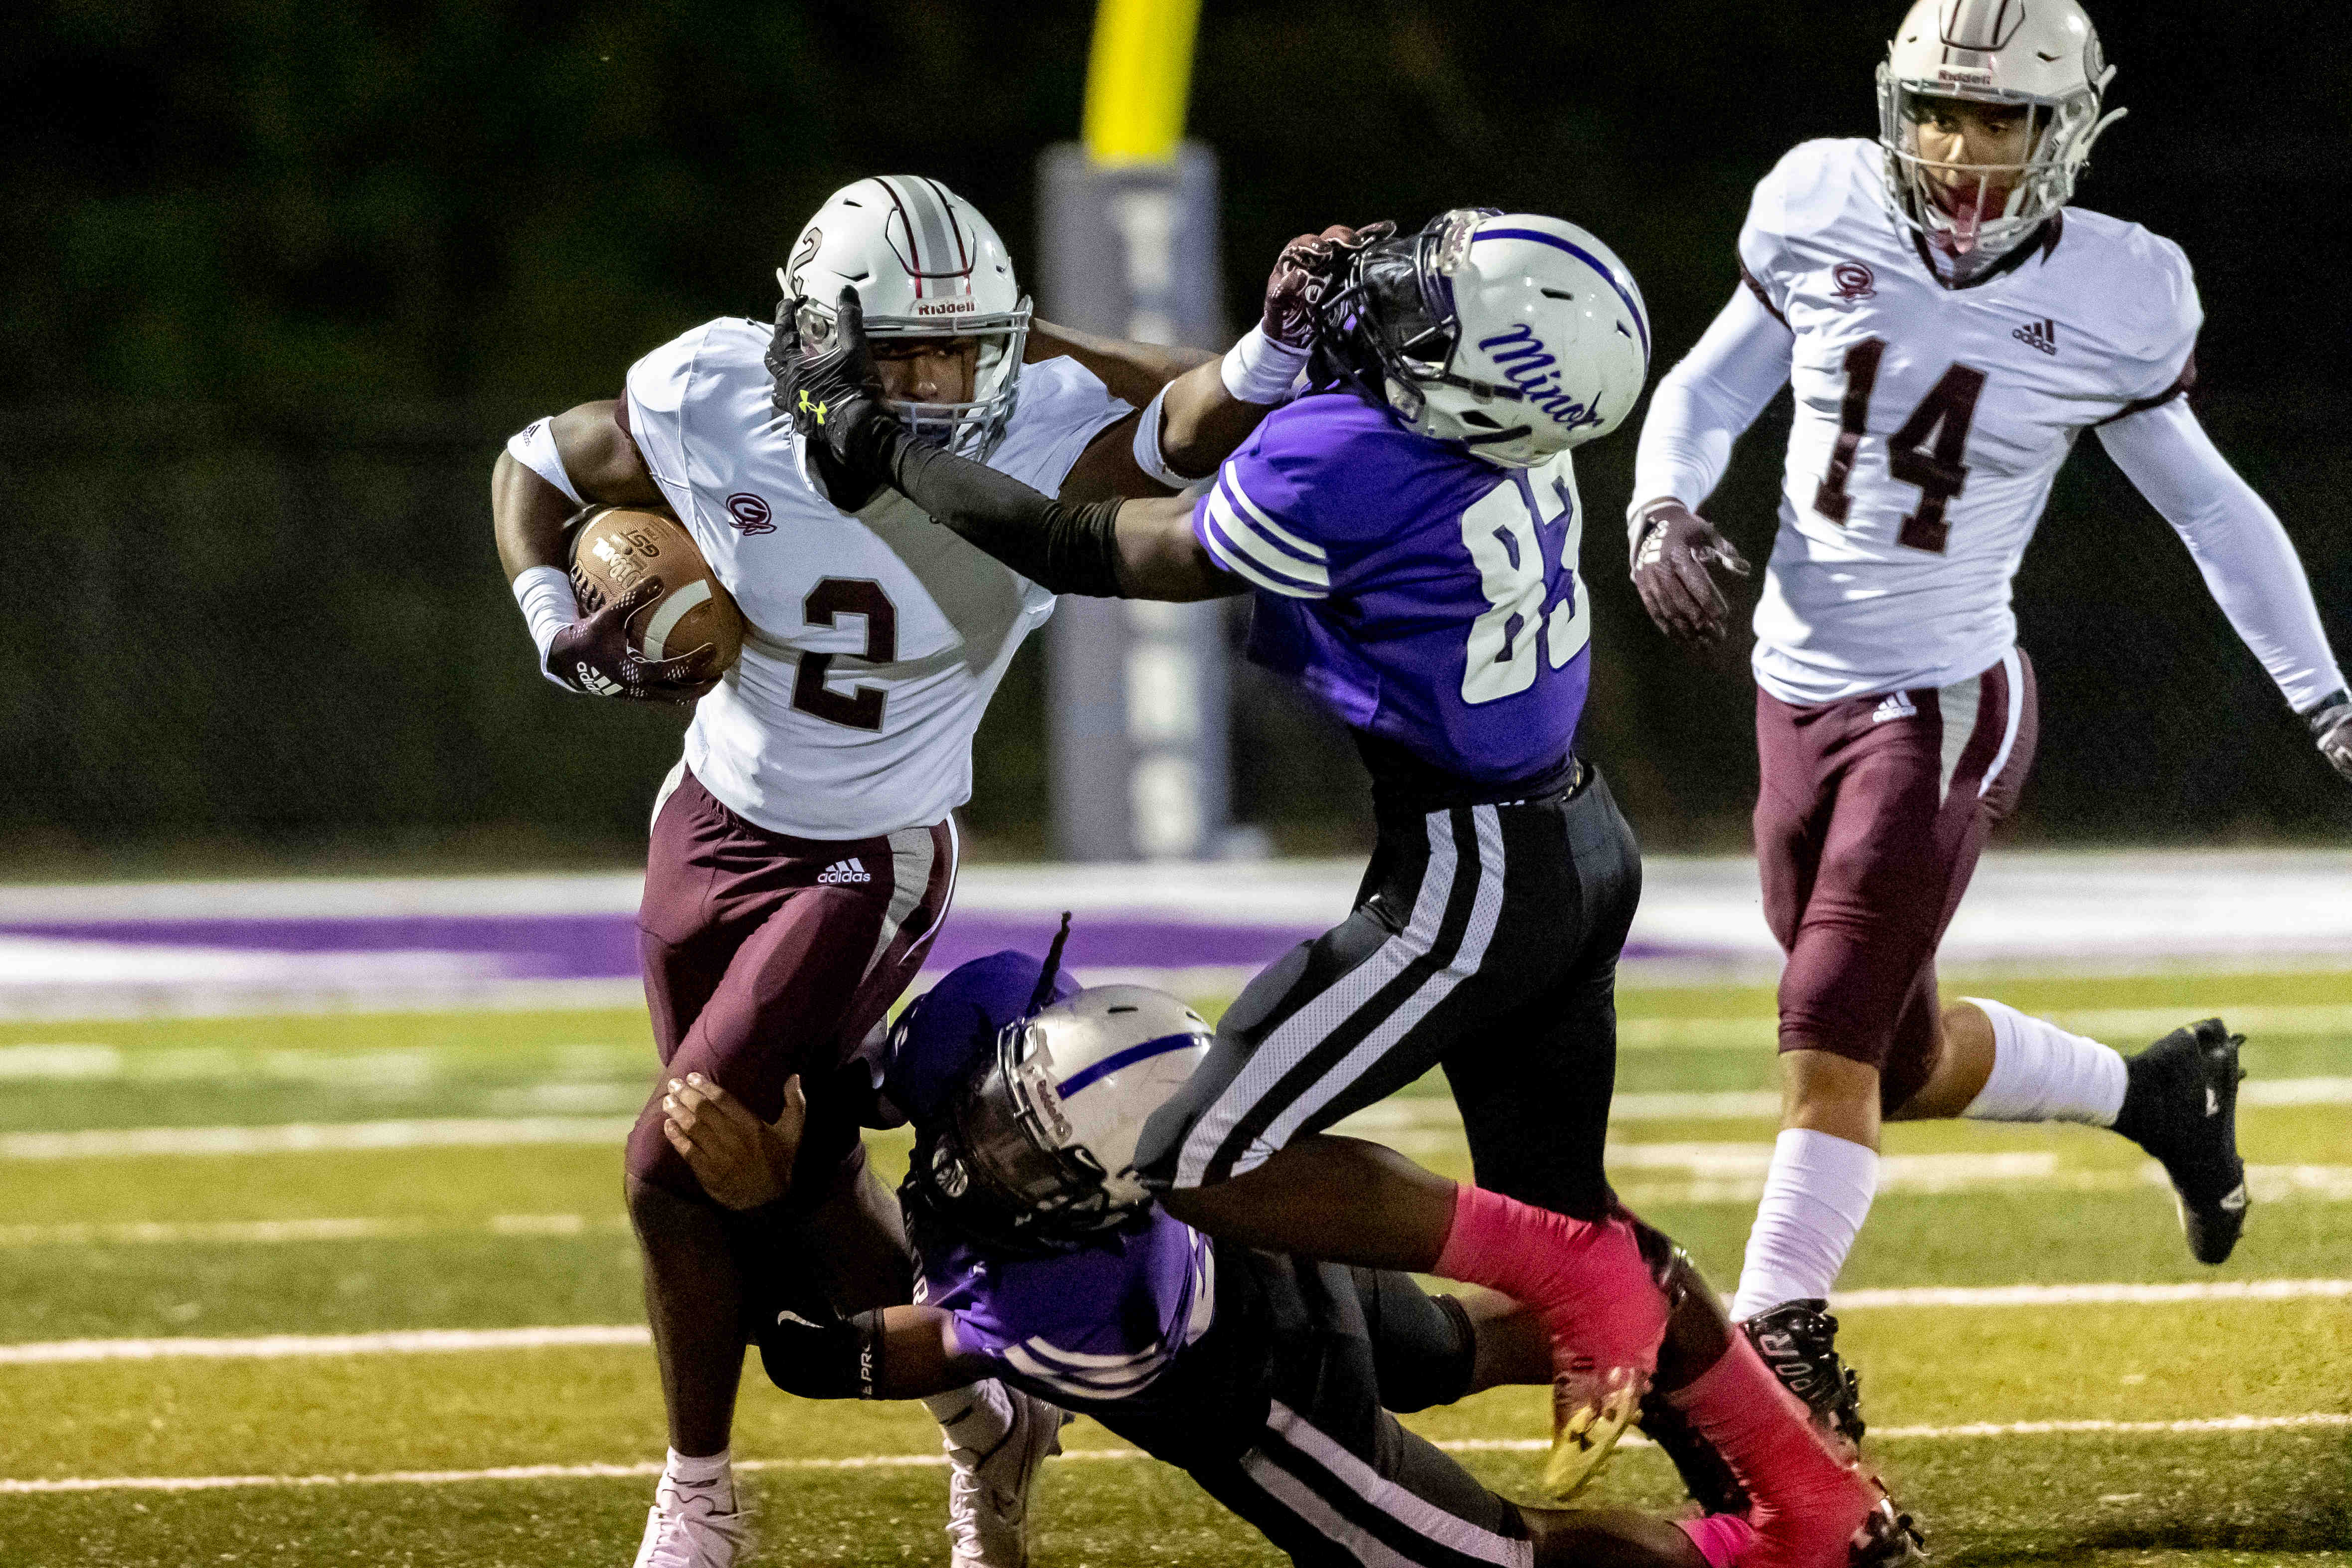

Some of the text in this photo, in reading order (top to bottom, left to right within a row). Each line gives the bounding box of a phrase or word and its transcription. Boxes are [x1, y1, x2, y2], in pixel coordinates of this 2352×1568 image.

[787, 227, 823, 297] 2
[918, 301, 975, 316] Riddell
[1478, 323, 1605, 431] Minor
[1812, 336, 1989, 556] 14
[1461, 449, 1590, 704] 83
[790, 575, 898, 734] 2
[817, 870, 871, 883] adidas
